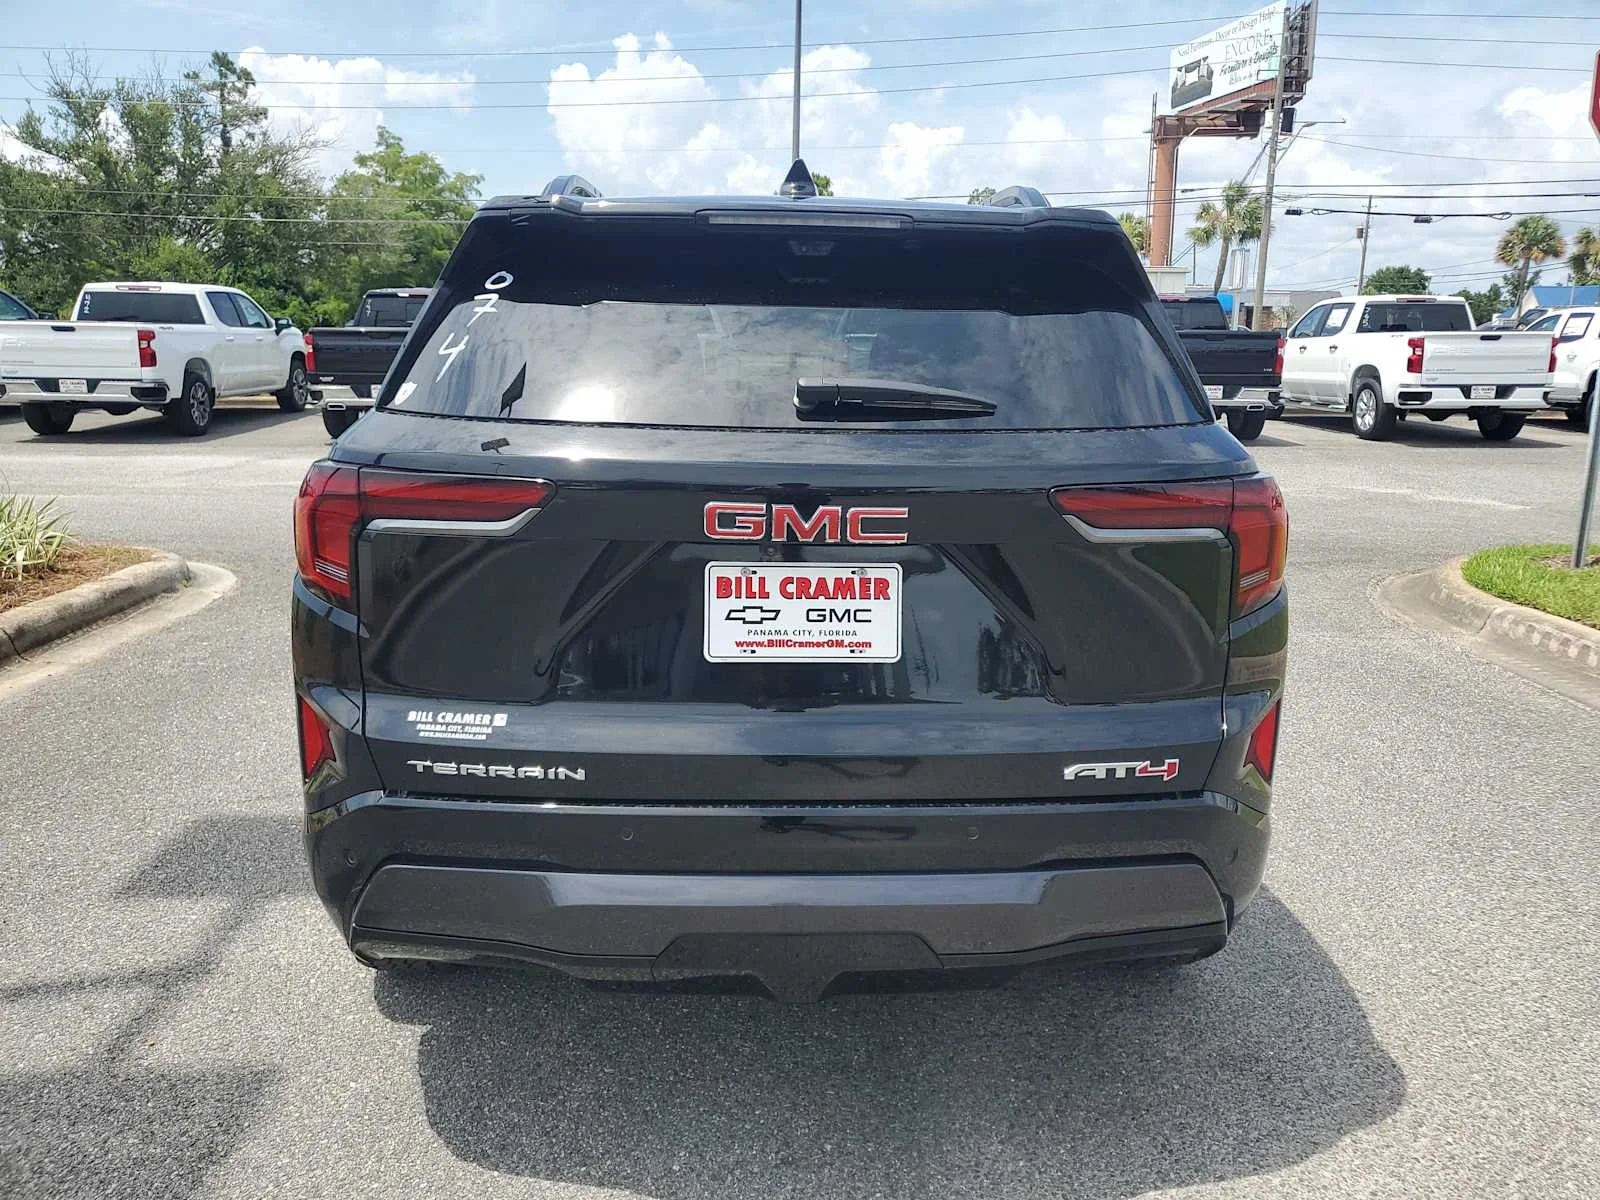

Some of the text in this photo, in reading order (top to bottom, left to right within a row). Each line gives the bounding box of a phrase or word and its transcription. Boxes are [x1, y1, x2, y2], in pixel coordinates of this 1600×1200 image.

[1238, 18, 1258, 32] Design
[1224, 28, 1271, 61] ENCORE
[703, 501, 909, 544] GMC
[715, 575, 891, 600] BILL CRAMER
[805, 608, 872, 623] GMC
[747, 629, 858, 638] PANAMA CITY, FLORIDA
[735, 639, 872, 649] www.BillCramerGM.com
[408, 711, 492, 725] BILL CRAMER
[406, 759, 587, 782] TERRAIN
[1063, 758, 1180, 782] AT4
